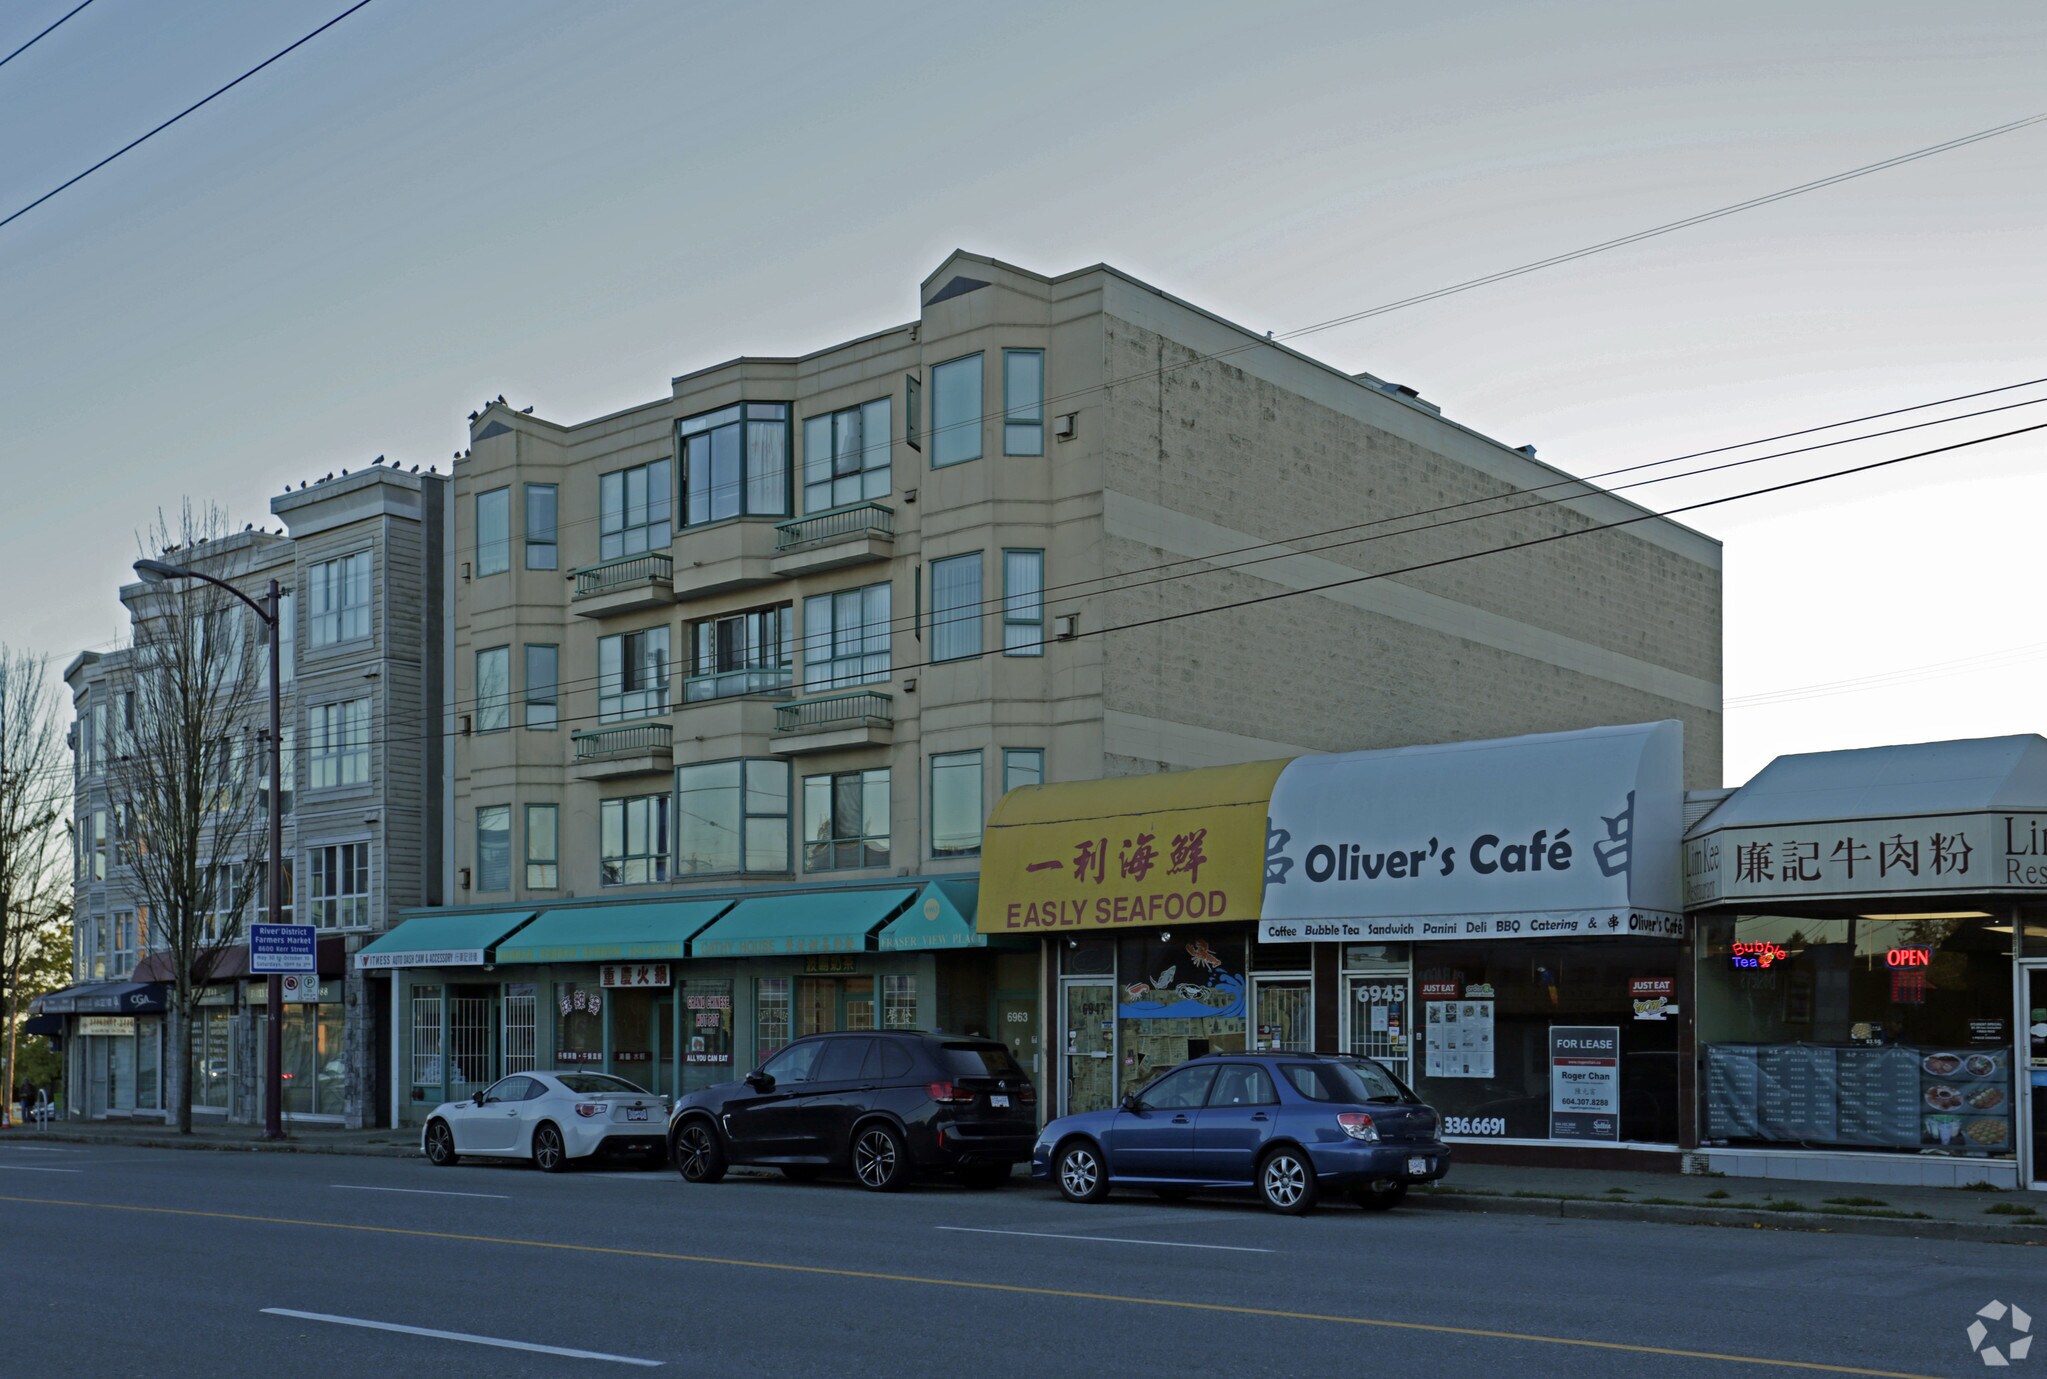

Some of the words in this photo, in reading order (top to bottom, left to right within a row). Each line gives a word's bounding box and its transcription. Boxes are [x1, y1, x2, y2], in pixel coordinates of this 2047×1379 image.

[2004, 817, 2047, 856] Li
[1025, 828, 1208, 885] 一利海鮮
[1305, 836, 1455, 882] Oliver's
[1470, 828, 1572, 875] Café
[1686, 844, 1702, 878] Lim
[1703, 838, 1719, 873] Kee
[1734, 832, 1973, 884] 廉記牛肉粉
[1006, 898, 1088, 928] EASLY
[1095, 890, 1227, 924] SEAFOOD
[259, 927, 278, 935] River
[281, 927, 308, 936] District
[1268, 926, 1297, 937] Coffee
[1305, 924, 1339, 936] Bubble
[1342, 924, 1360, 935] Tea
[1368, 923, 1414, 936] Sandwich
[1423, 922, 1457, 934] Panini
[1466, 921, 1487, 933] Deli
[1496, 920, 1520, 934] BBQ
[1530, 918, 1578, 932] Catering
[1588, 917, 1597, 929] &
[1629, 913, 1662, 933] Oliver's
[1664, 917, 1683, 935] Café
[255, 936, 285, 944] Farmers
[287, 937, 312, 945] Market
[880, 936, 918, 948] FRASER
[922, 934, 947, 946] VIEW
[404, 954, 414, 965] DASH
[415, 954, 424, 964] CAM
[429, 952, 453, 964] ACCESSORY
[1732, 940, 1787, 960] Bubble
[1887, 949, 1929, 966] OPEN
[1732, 956, 1758, 968] Tea
[603, 964, 668, 986] 重慶火鍋
[1358, 985, 1405, 1002] 6945
[1632, 981, 1654, 990] JUST
[1654, 981, 1671, 990] EAT
[130, 994, 151, 1005] CGA
[1008, 1012, 1028, 1022] 6963
[1557, 1039, 1577, 1049] FOR
[1580, 1039, 1613, 1050] LEASE
[1562, 1072, 1586, 1082] Roger
[1588, 1072, 1610, 1080] Chan
[1562, 1098, 1609, 1106] 604.307.8288
